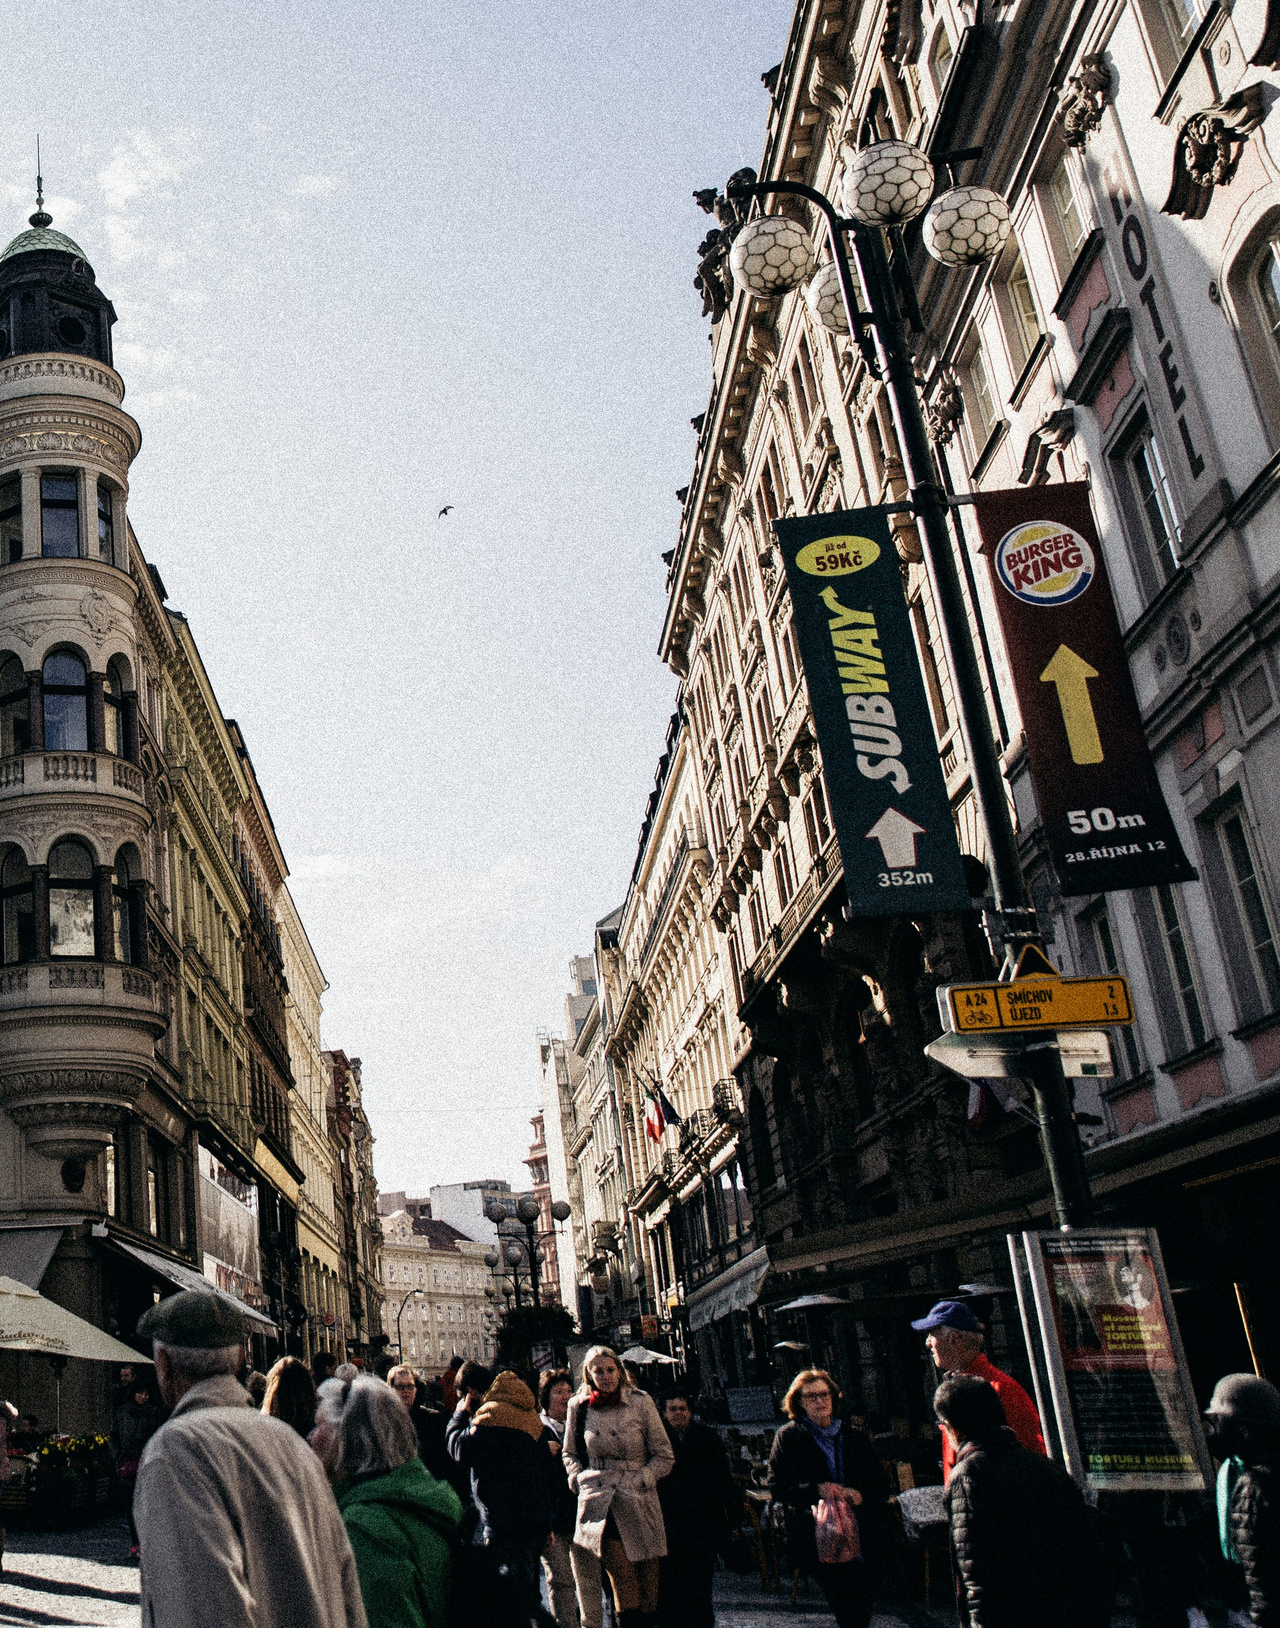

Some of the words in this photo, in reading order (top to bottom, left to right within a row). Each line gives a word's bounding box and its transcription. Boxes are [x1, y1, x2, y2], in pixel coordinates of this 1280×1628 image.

[836, 541, 847, 551] od
[1005, 531, 1076, 572] BURGER
[815, 550, 863, 573] 59Kč
[1012, 550, 1085, 591] KING
[818, 586, 912, 795] SUBWAY
[1066, 806, 1145, 836] 50m
[1146, 839, 1167, 853] 12
[878, 869, 934, 888] 352m
[965, 994, 973, 1007] A
[974, 992, 988, 1006] 24
[1006, 988, 1053, 1005] SMÍCHOV
[1107, 986, 1115, 999] 2
[1010, 1005, 1042, 1021] ÚJEZD
[1087, 1454, 1142, 1465] TORTURE
